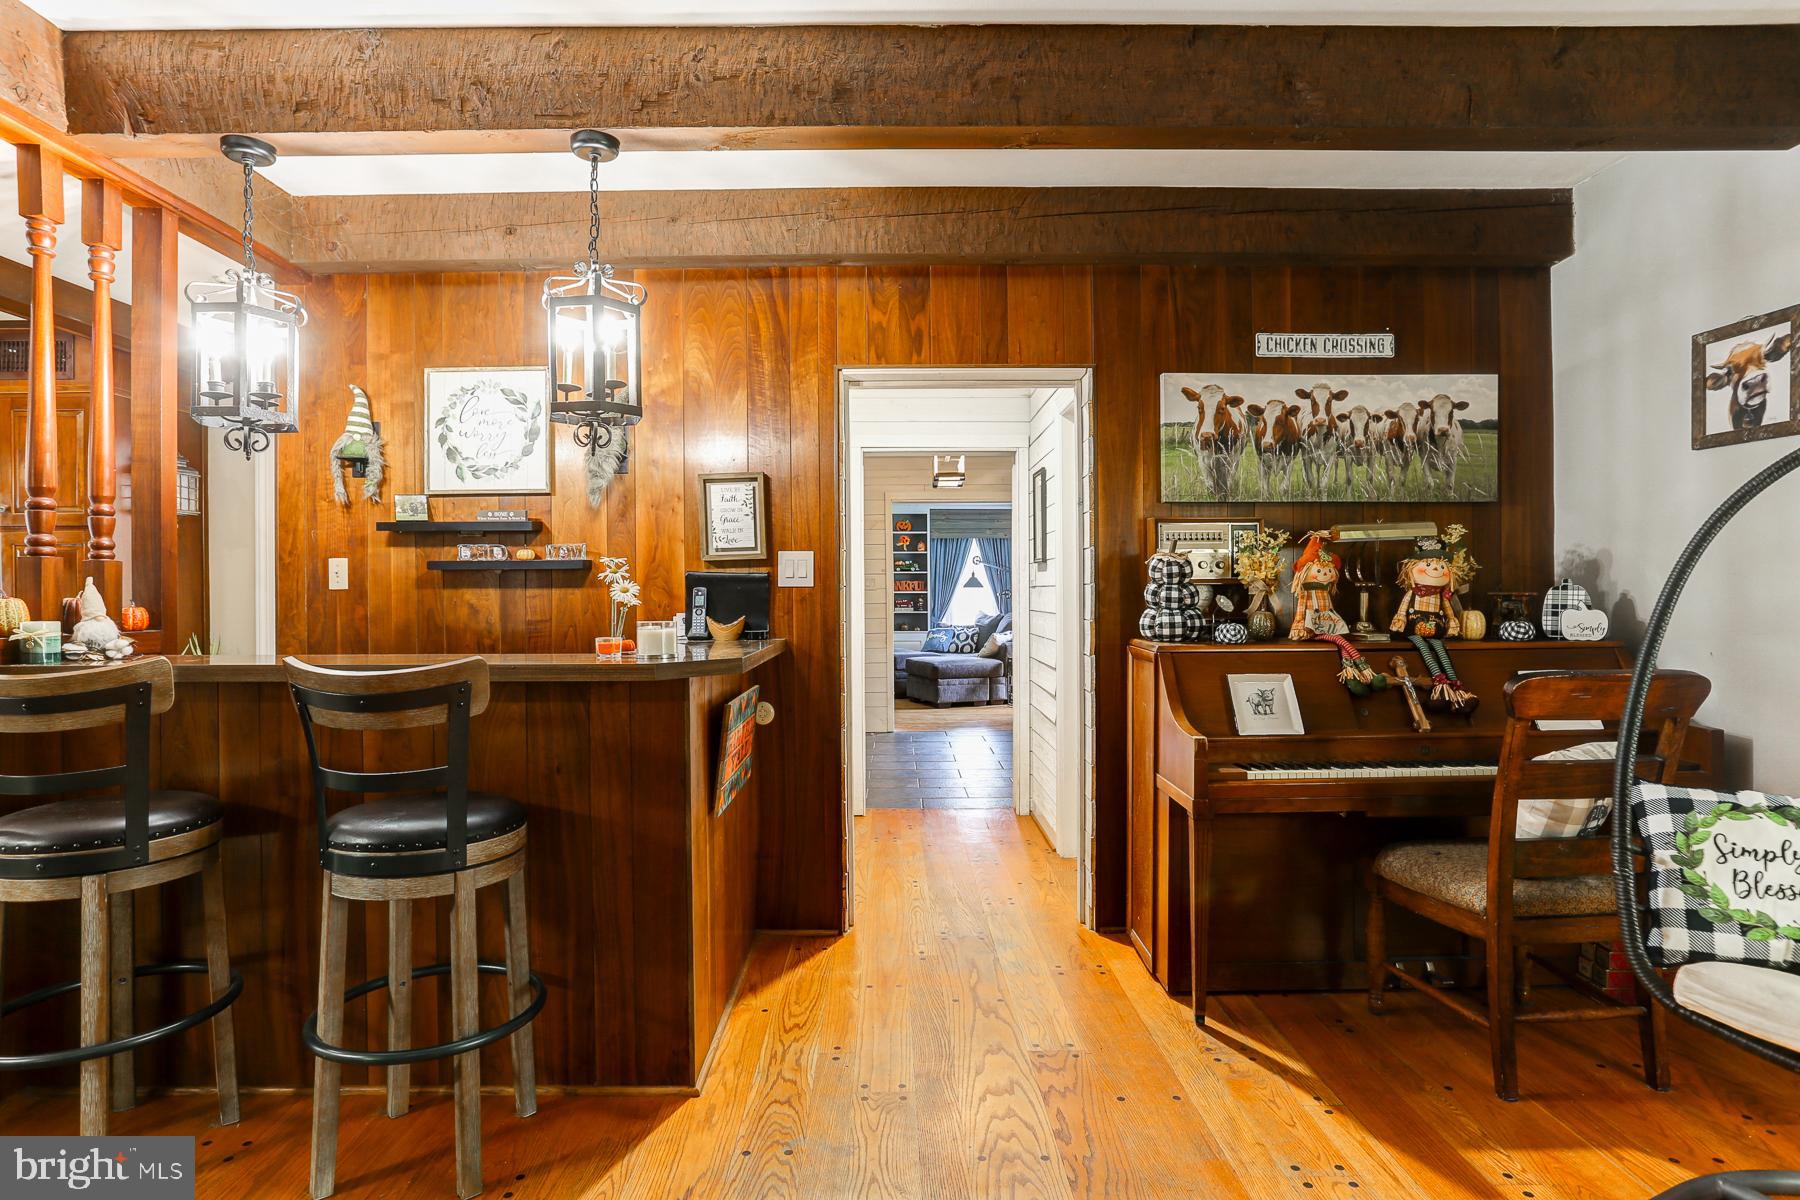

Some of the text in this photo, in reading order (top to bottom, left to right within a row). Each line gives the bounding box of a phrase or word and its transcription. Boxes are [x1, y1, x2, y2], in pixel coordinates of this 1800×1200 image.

[1266, 336, 1385, 354] CHICKEN CROSSING
[1733, 868, 1800, 901] Bless
